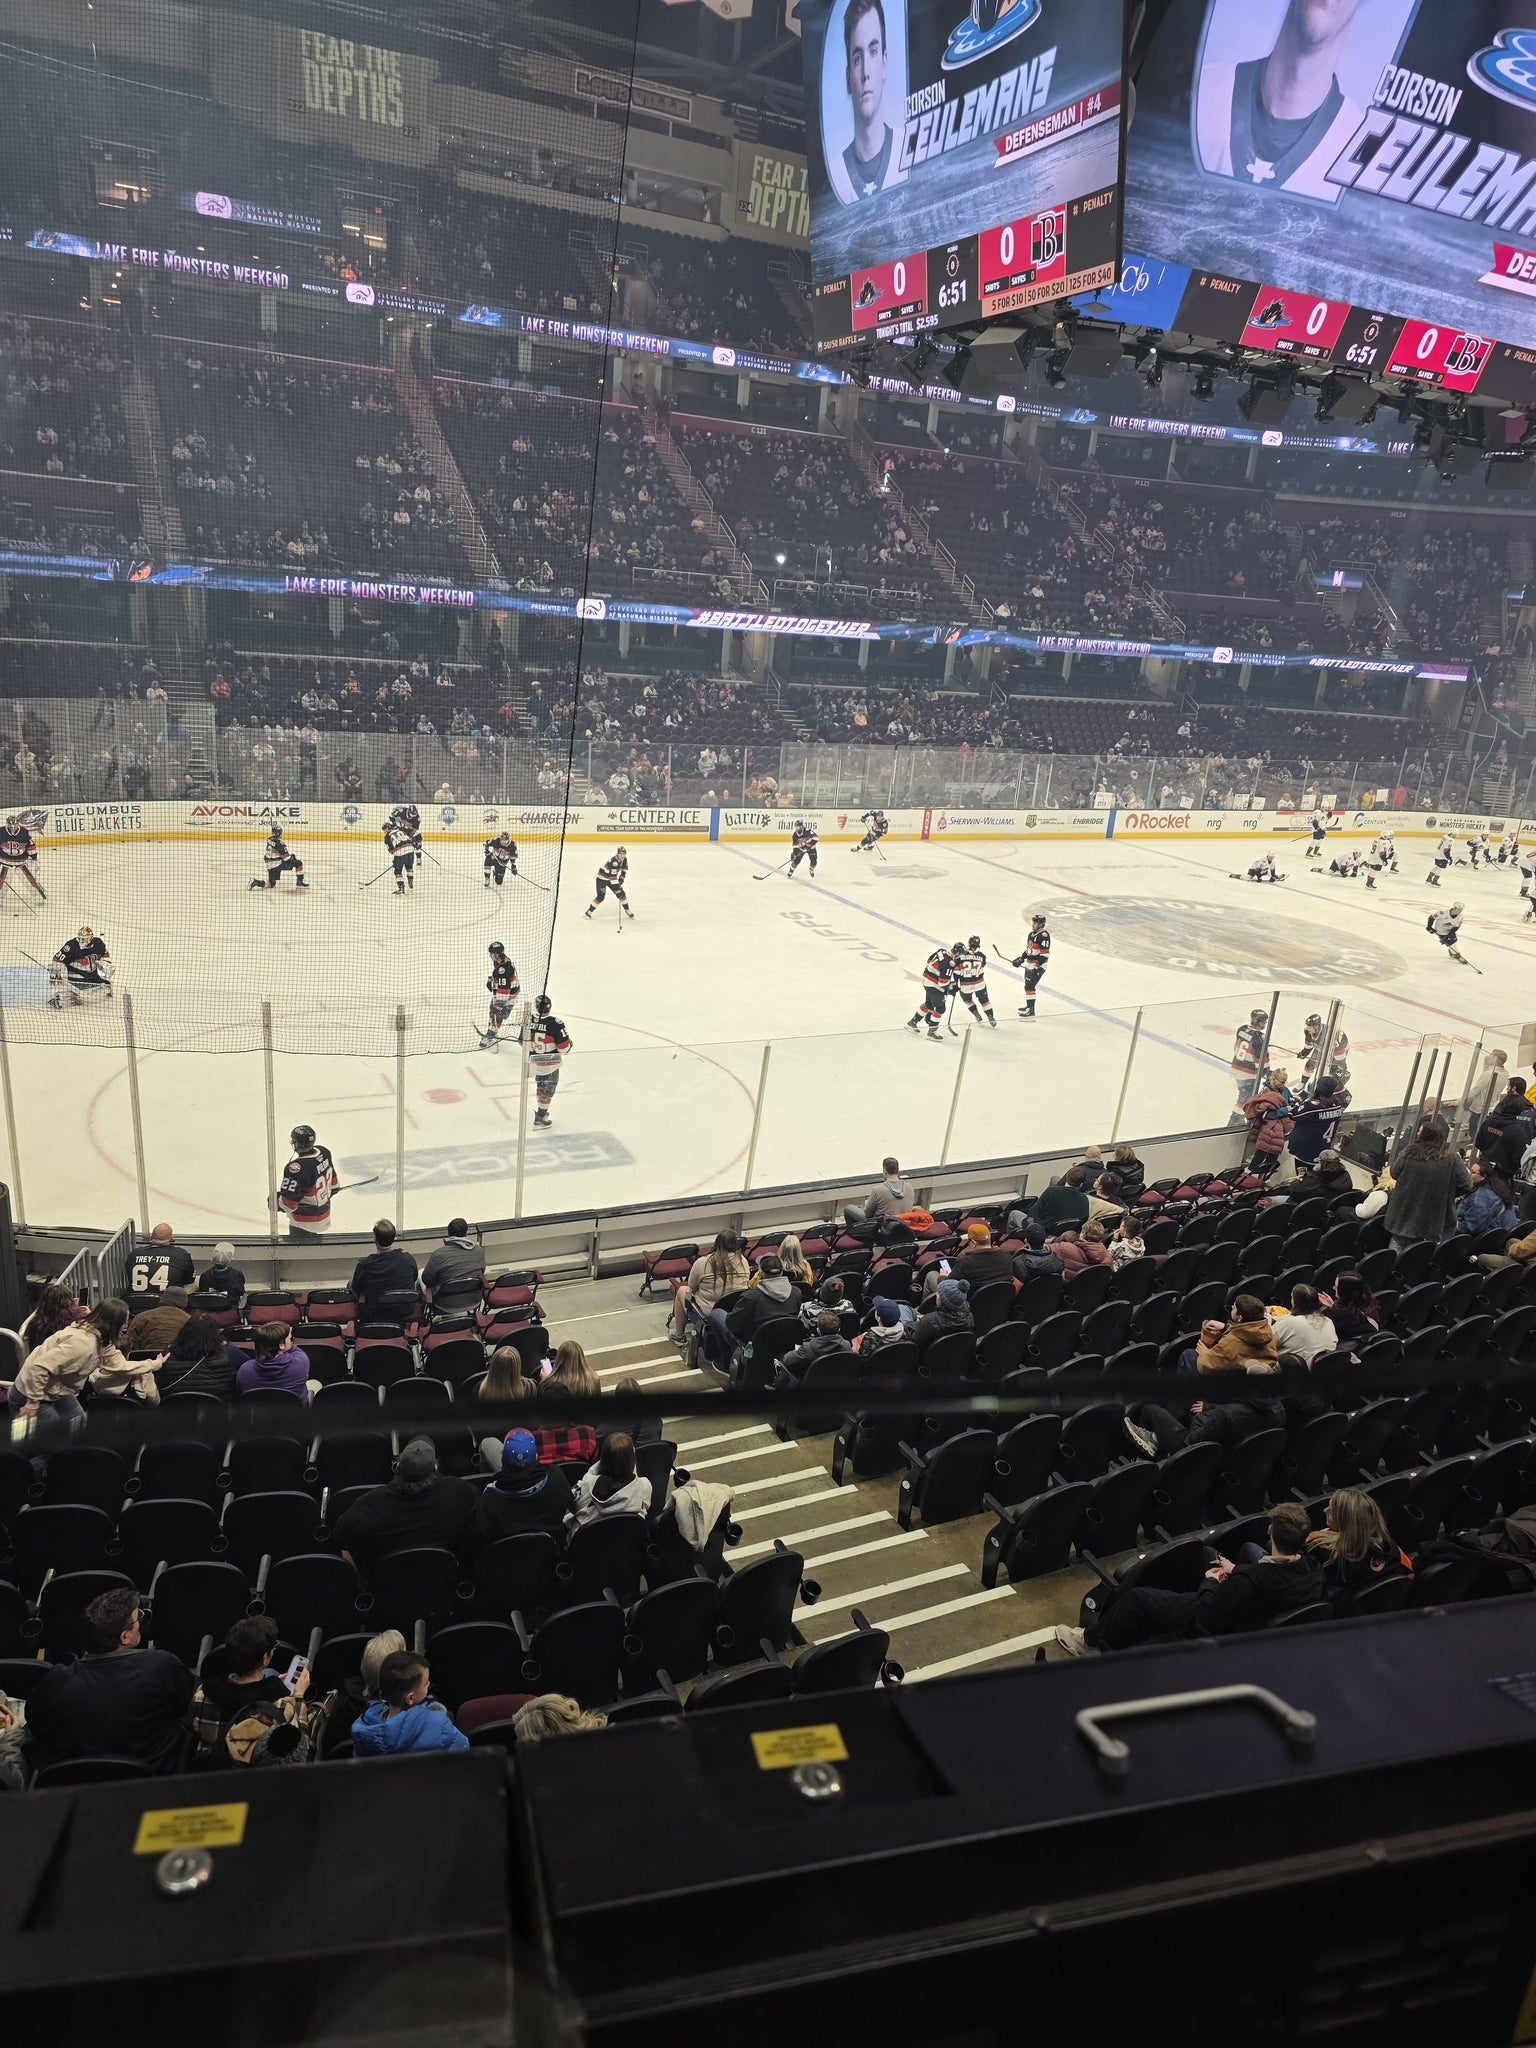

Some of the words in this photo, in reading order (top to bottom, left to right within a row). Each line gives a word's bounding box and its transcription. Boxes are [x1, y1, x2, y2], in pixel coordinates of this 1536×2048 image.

[301, 28, 354, 68] FEAR
[362, 44, 401, 80] THE
[303, 58, 403, 128] DEPTHS
[905, 78, 946, 119] CORSON
[1373, 64, 1463, 126] CORSON
[898, 46, 1057, 172] CEULEMANS
[1005, 105, 1076, 153] DEFENSEMAN
[752, 155, 794, 189] FEAR
[740, 202, 752, 212] 224
[1083, 191, 1114, 213] PENALTY
[286, 221, 321, 232] HISTORY
[1000, 227, 1014, 266] 0
[96, 241, 128, 263] LAKE
[132, 248, 159, 267] ERIE
[164, 253, 230, 280] MONSTERS
[233, 265, 289, 290] WEEKEND
[823, 280, 846, 295] PENALTY
[893, 262, 906, 296] 0
[992, 300, 997, 311] 5
[997, 297, 1010, 310] FOR
[1011, 294, 1023, 307] $10
[1027, 289, 1036, 302] 50
[1037, 286, 1050, 299] FOR
[1051, 281, 1064, 296] $20
[1069, 278, 1082, 291] 125
[1083, 274, 1096, 287] FOR
[1097, 267, 1112, 284] $40
[1209, 278, 1242, 295] PENALTY
[938, 279, 967, 308] 6:51
[417, 306, 446, 315] HISTORY
[1306, 302, 1328, 336] 0
[916, 314, 939, 331] $2,595
[520, 315, 545, 334] LAKE
[548, 320, 569, 338] ERIE
[572, 324, 624, 347] MONSTERS
[626, 334, 670, 354] WEEKEND
[839, 335, 857, 348] RAFFLE
[1416, 328, 1438, 360] 0
[1346, 343, 1377, 366] 6:51
[1109, 416, 1127, 429] LAKE
[1128, 419, 1146, 431] ERIE
[1147, 420, 1189, 436] MONSTERS
[1190, 425, 1226, 439] WEEKEND
[1387, 442, 1408, 454] LAKE
[285, 576, 316, 593] LAKE
[320, 578, 347, 596] ERIE
[352, 581, 416, 601] MONSTERS
[420, 587, 474, 606] WEEKEND
[531, 603, 560, 612] PRESENTED
[609, 605, 648, 613] CLEVELAND
[617, 612, 646, 620] NATURAL
[650, 614, 677, 622] HISTORY
[1037, 636, 1055, 649] LAKE
[1057, 638, 1074, 650] ERIE
[1076, 639, 1115, 653] MONSTERS
[1117, 641, 1151, 655] WEEKEND
[54, 805, 141, 817] COLUMBUS
[620, 810, 675, 823] CENTER
[680, 810, 700, 823] ICE
[1140, 813, 1190, 829] Rocket
[55, 818, 85, 833] BLUE
[90, 816, 142, 830] JACKETS
[1207, 820, 1221, 830] nrg
[1243, 820, 1257, 830] nrg
[779, 911, 899, 962] CLIFFS
[962, 962, 981, 977] 27
[282, 1177, 297, 1192] 22
[135, 1255, 170, 1264] TREY-TOR
[132, 1265, 169, 1291] 64
